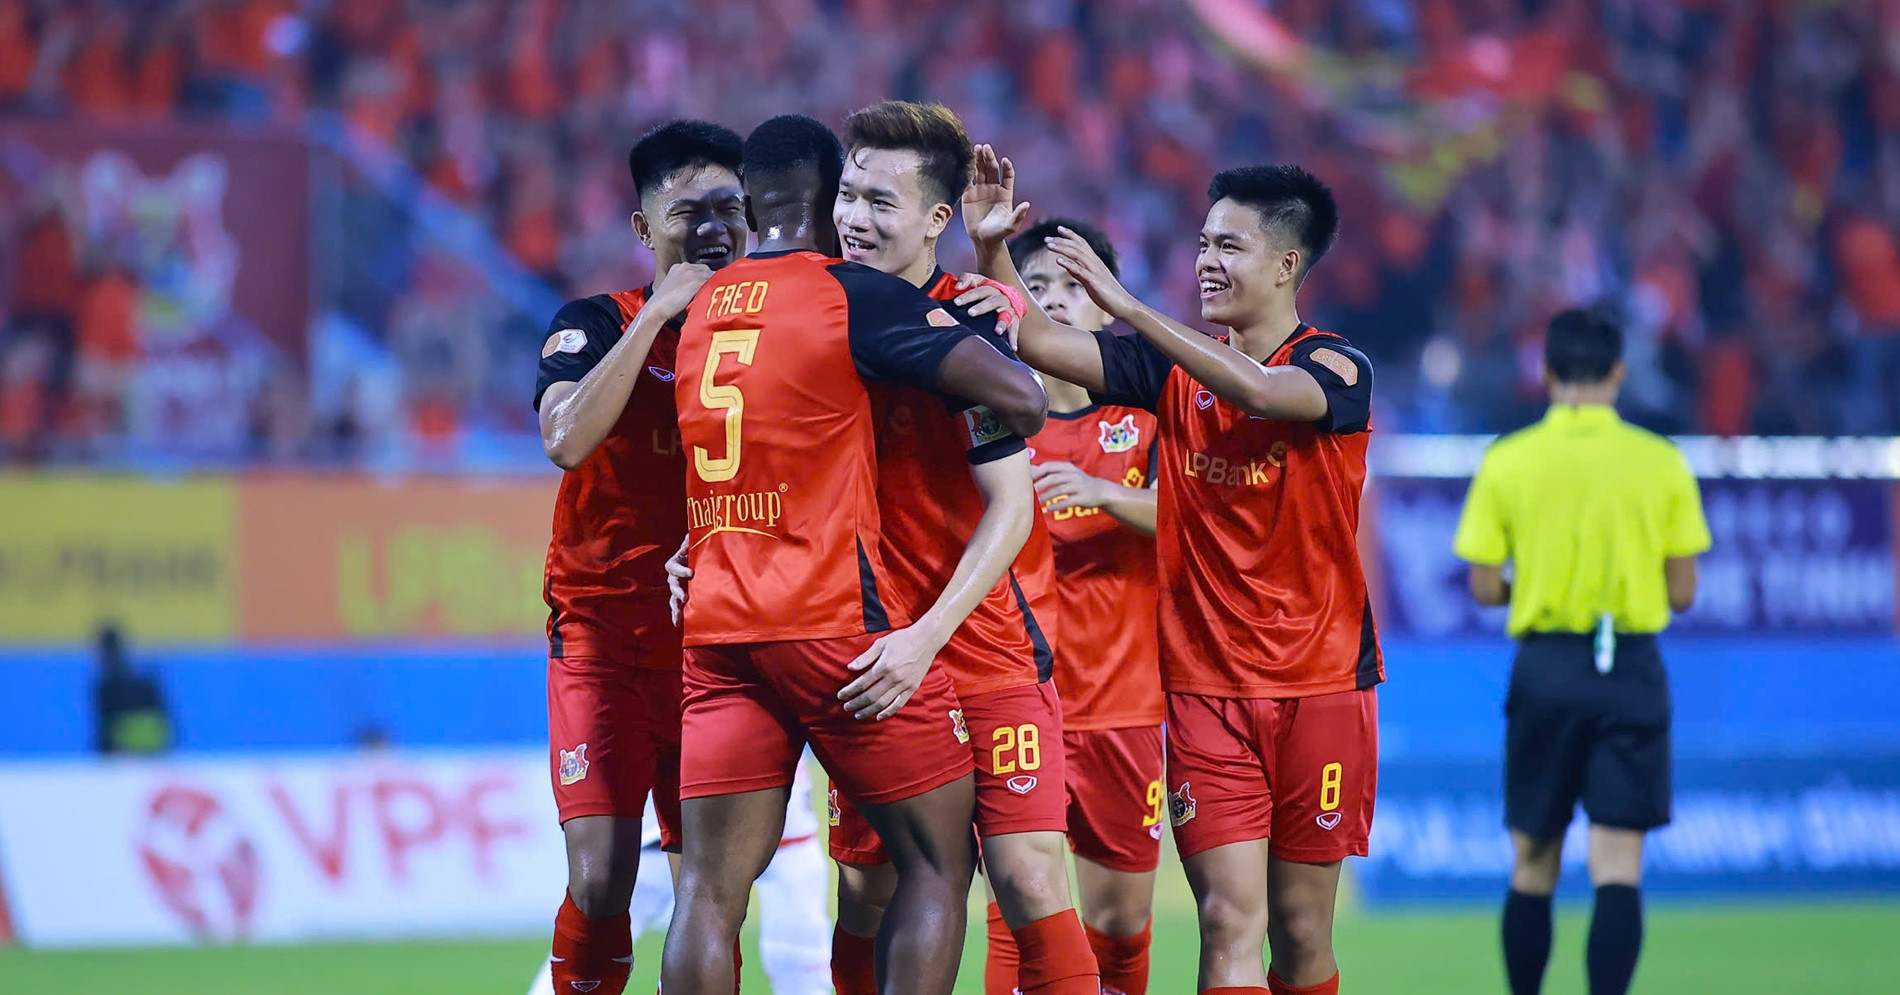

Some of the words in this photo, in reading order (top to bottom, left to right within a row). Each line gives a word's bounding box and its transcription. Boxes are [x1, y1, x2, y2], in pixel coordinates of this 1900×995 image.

[706, 281, 769, 320] FRED
[693, 329, 761, 483] 5
[1184, 448, 1270, 486] LPBank
[991, 723, 1041, 776] 28
[1142, 776, 1164, 827] 9
[1320, 762, 1342, 811] 8
[265, 774, 530, 885] VPF
